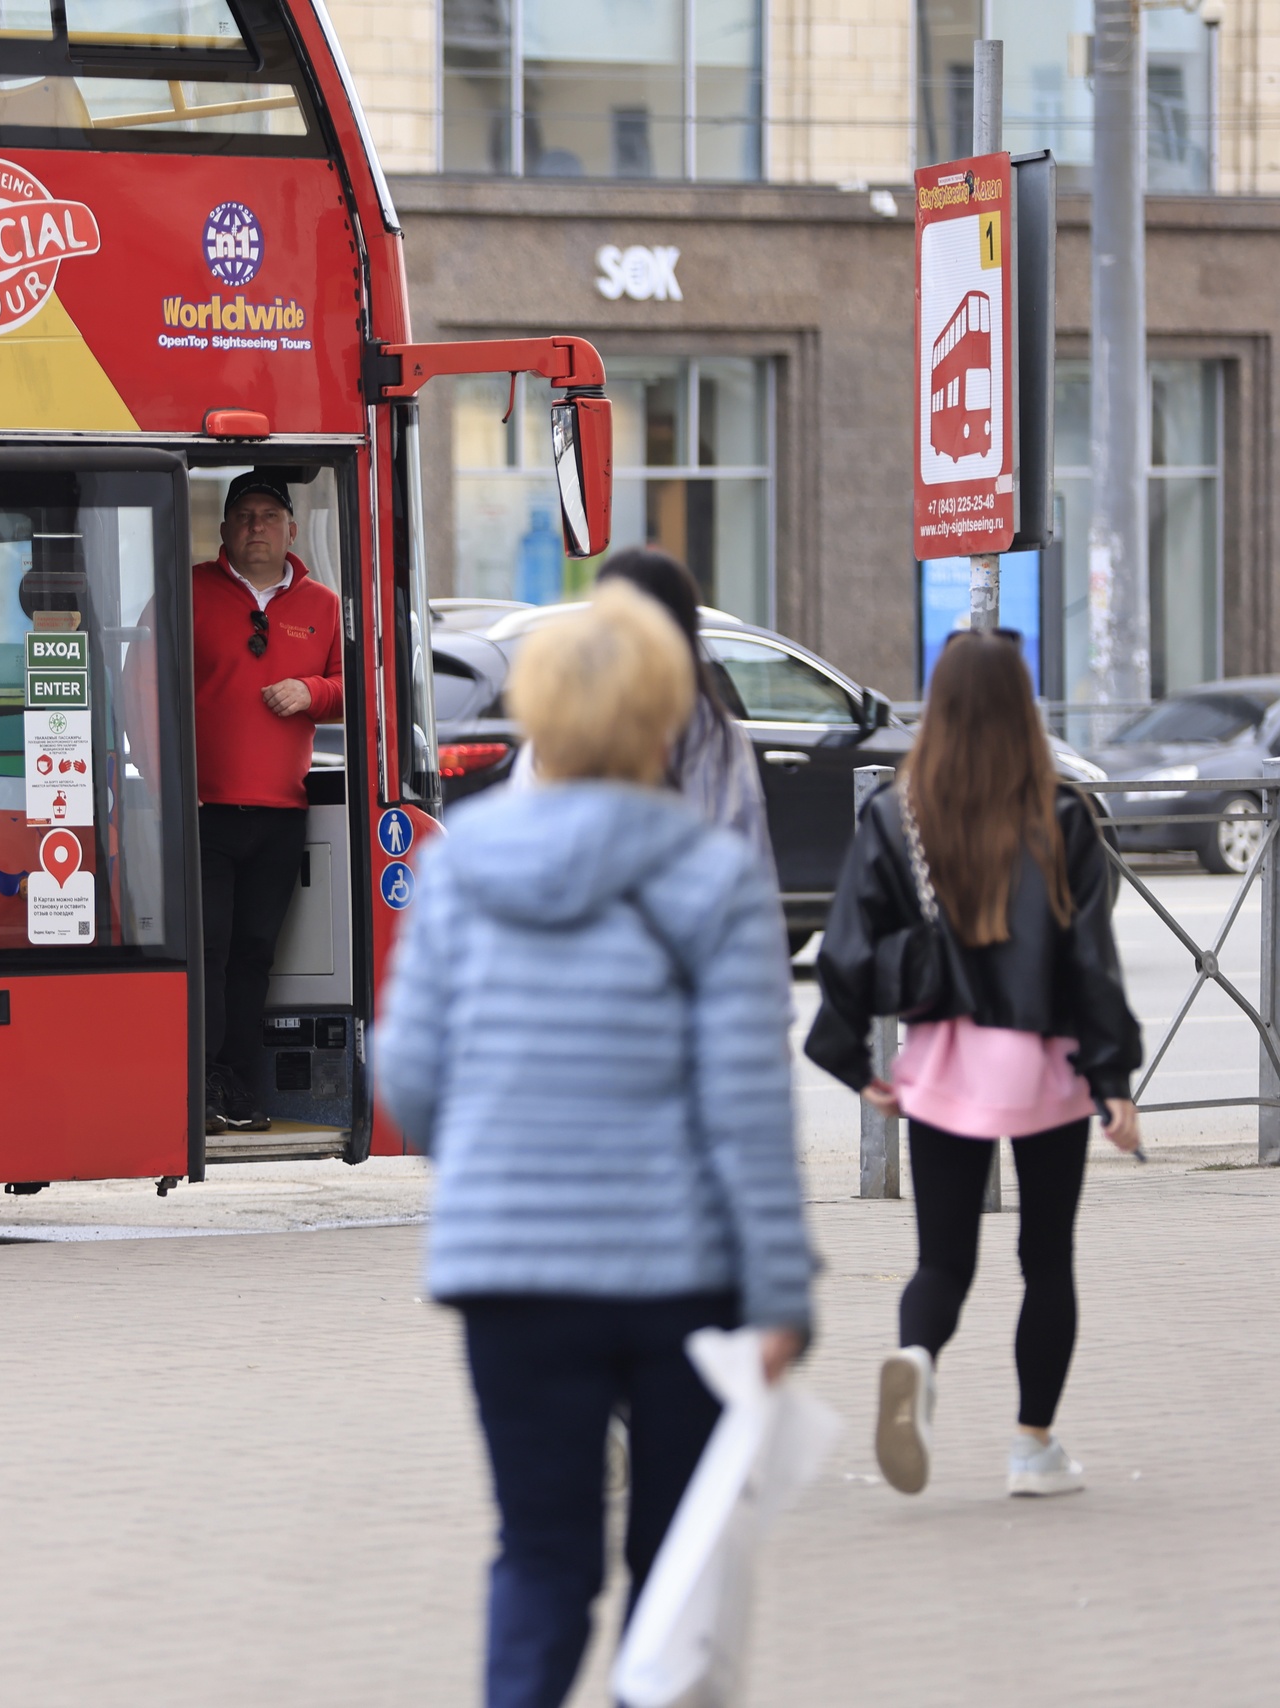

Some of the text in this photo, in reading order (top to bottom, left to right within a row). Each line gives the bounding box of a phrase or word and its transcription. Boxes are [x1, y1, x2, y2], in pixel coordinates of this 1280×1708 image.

[973, 177, 1003, 202] Kazan
[209, 203, 254, 219] Operador
[986, 221, 993, 261] 1
[211, 268, 254, 286] Oerator
[594, 244, 683, 300] SOK
[163, 295, 305, 330] Worldwide
[158, 334, 312, 350] OpenTop Sightseeing Tours
[928, 493, 994, 518] +7 (843) 225-25-48
[920, 516, 1004, 538] www.city-sightseeing.ru
[33, 642, 80, 659] ВХОД
[34, 682, 80, 695] ENTER
